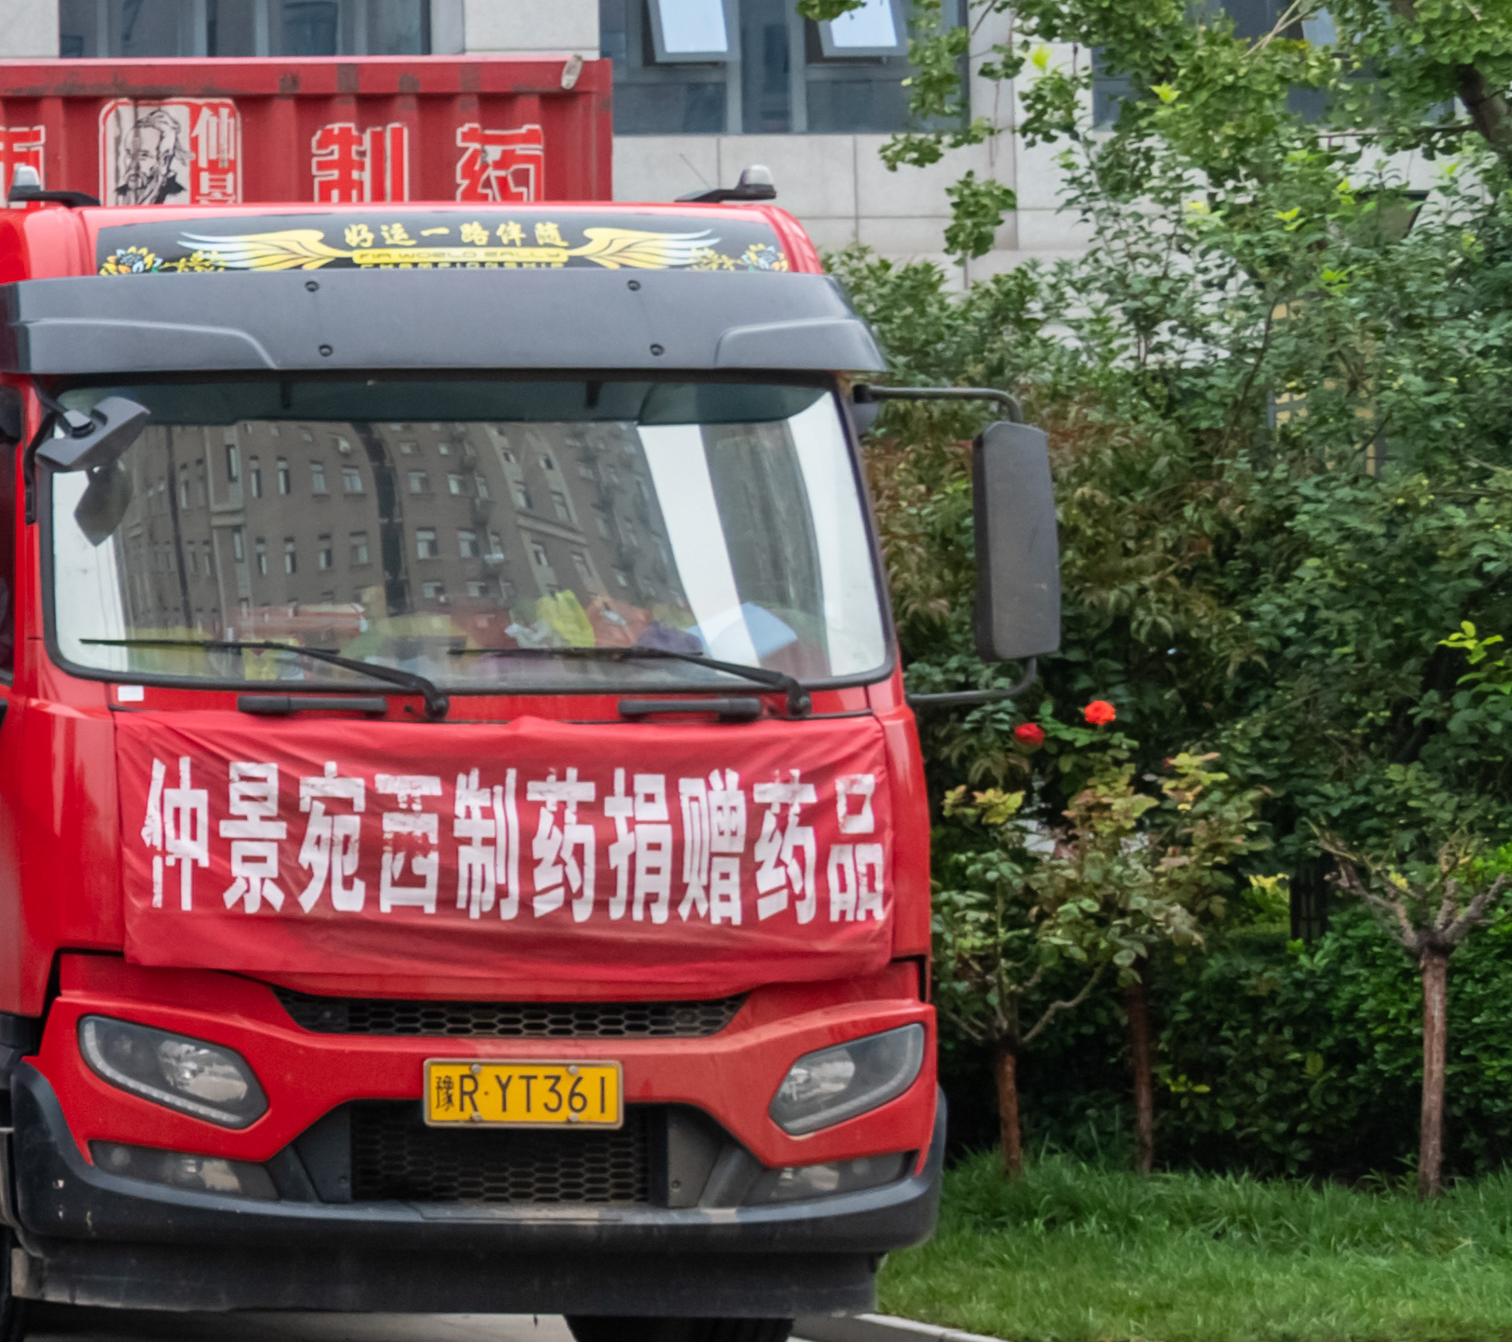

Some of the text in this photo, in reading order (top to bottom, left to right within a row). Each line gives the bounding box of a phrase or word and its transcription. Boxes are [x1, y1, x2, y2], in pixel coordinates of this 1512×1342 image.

[140, 756, 886, 926] 仲景宛西制药捐赠药品
